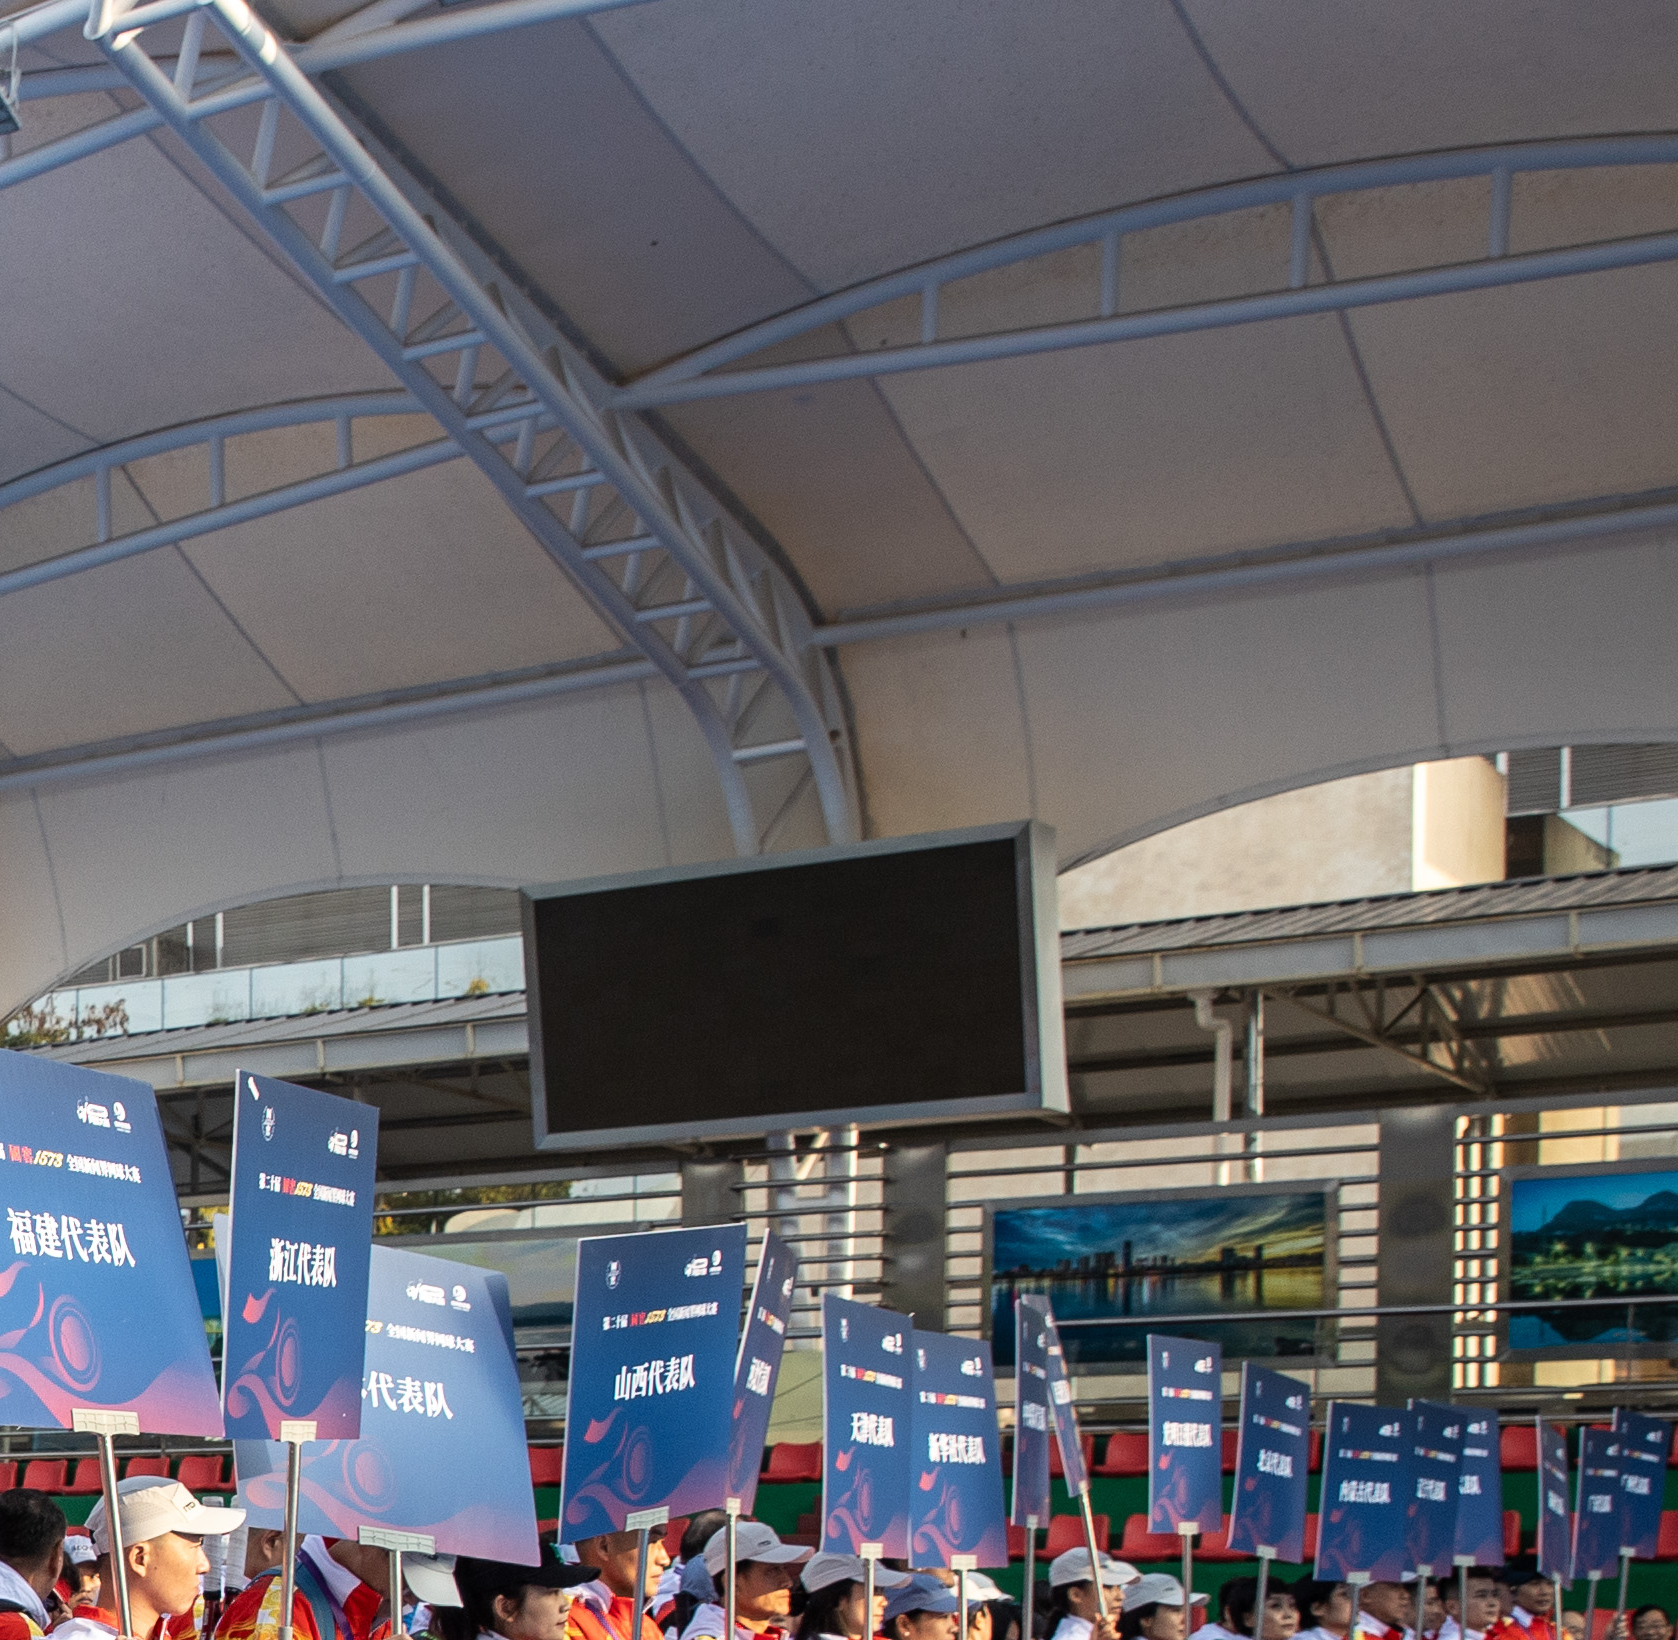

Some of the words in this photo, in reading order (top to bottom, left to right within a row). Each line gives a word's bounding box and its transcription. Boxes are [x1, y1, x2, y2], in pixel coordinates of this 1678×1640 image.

[7, 1207, 136, 1267] 福建代表队
[269, 1238, 337, 1287] 浙江代表队
[362, 1371, 453, 1419] 代表队
[614, 1354, 696, 1400] 山西代表队
